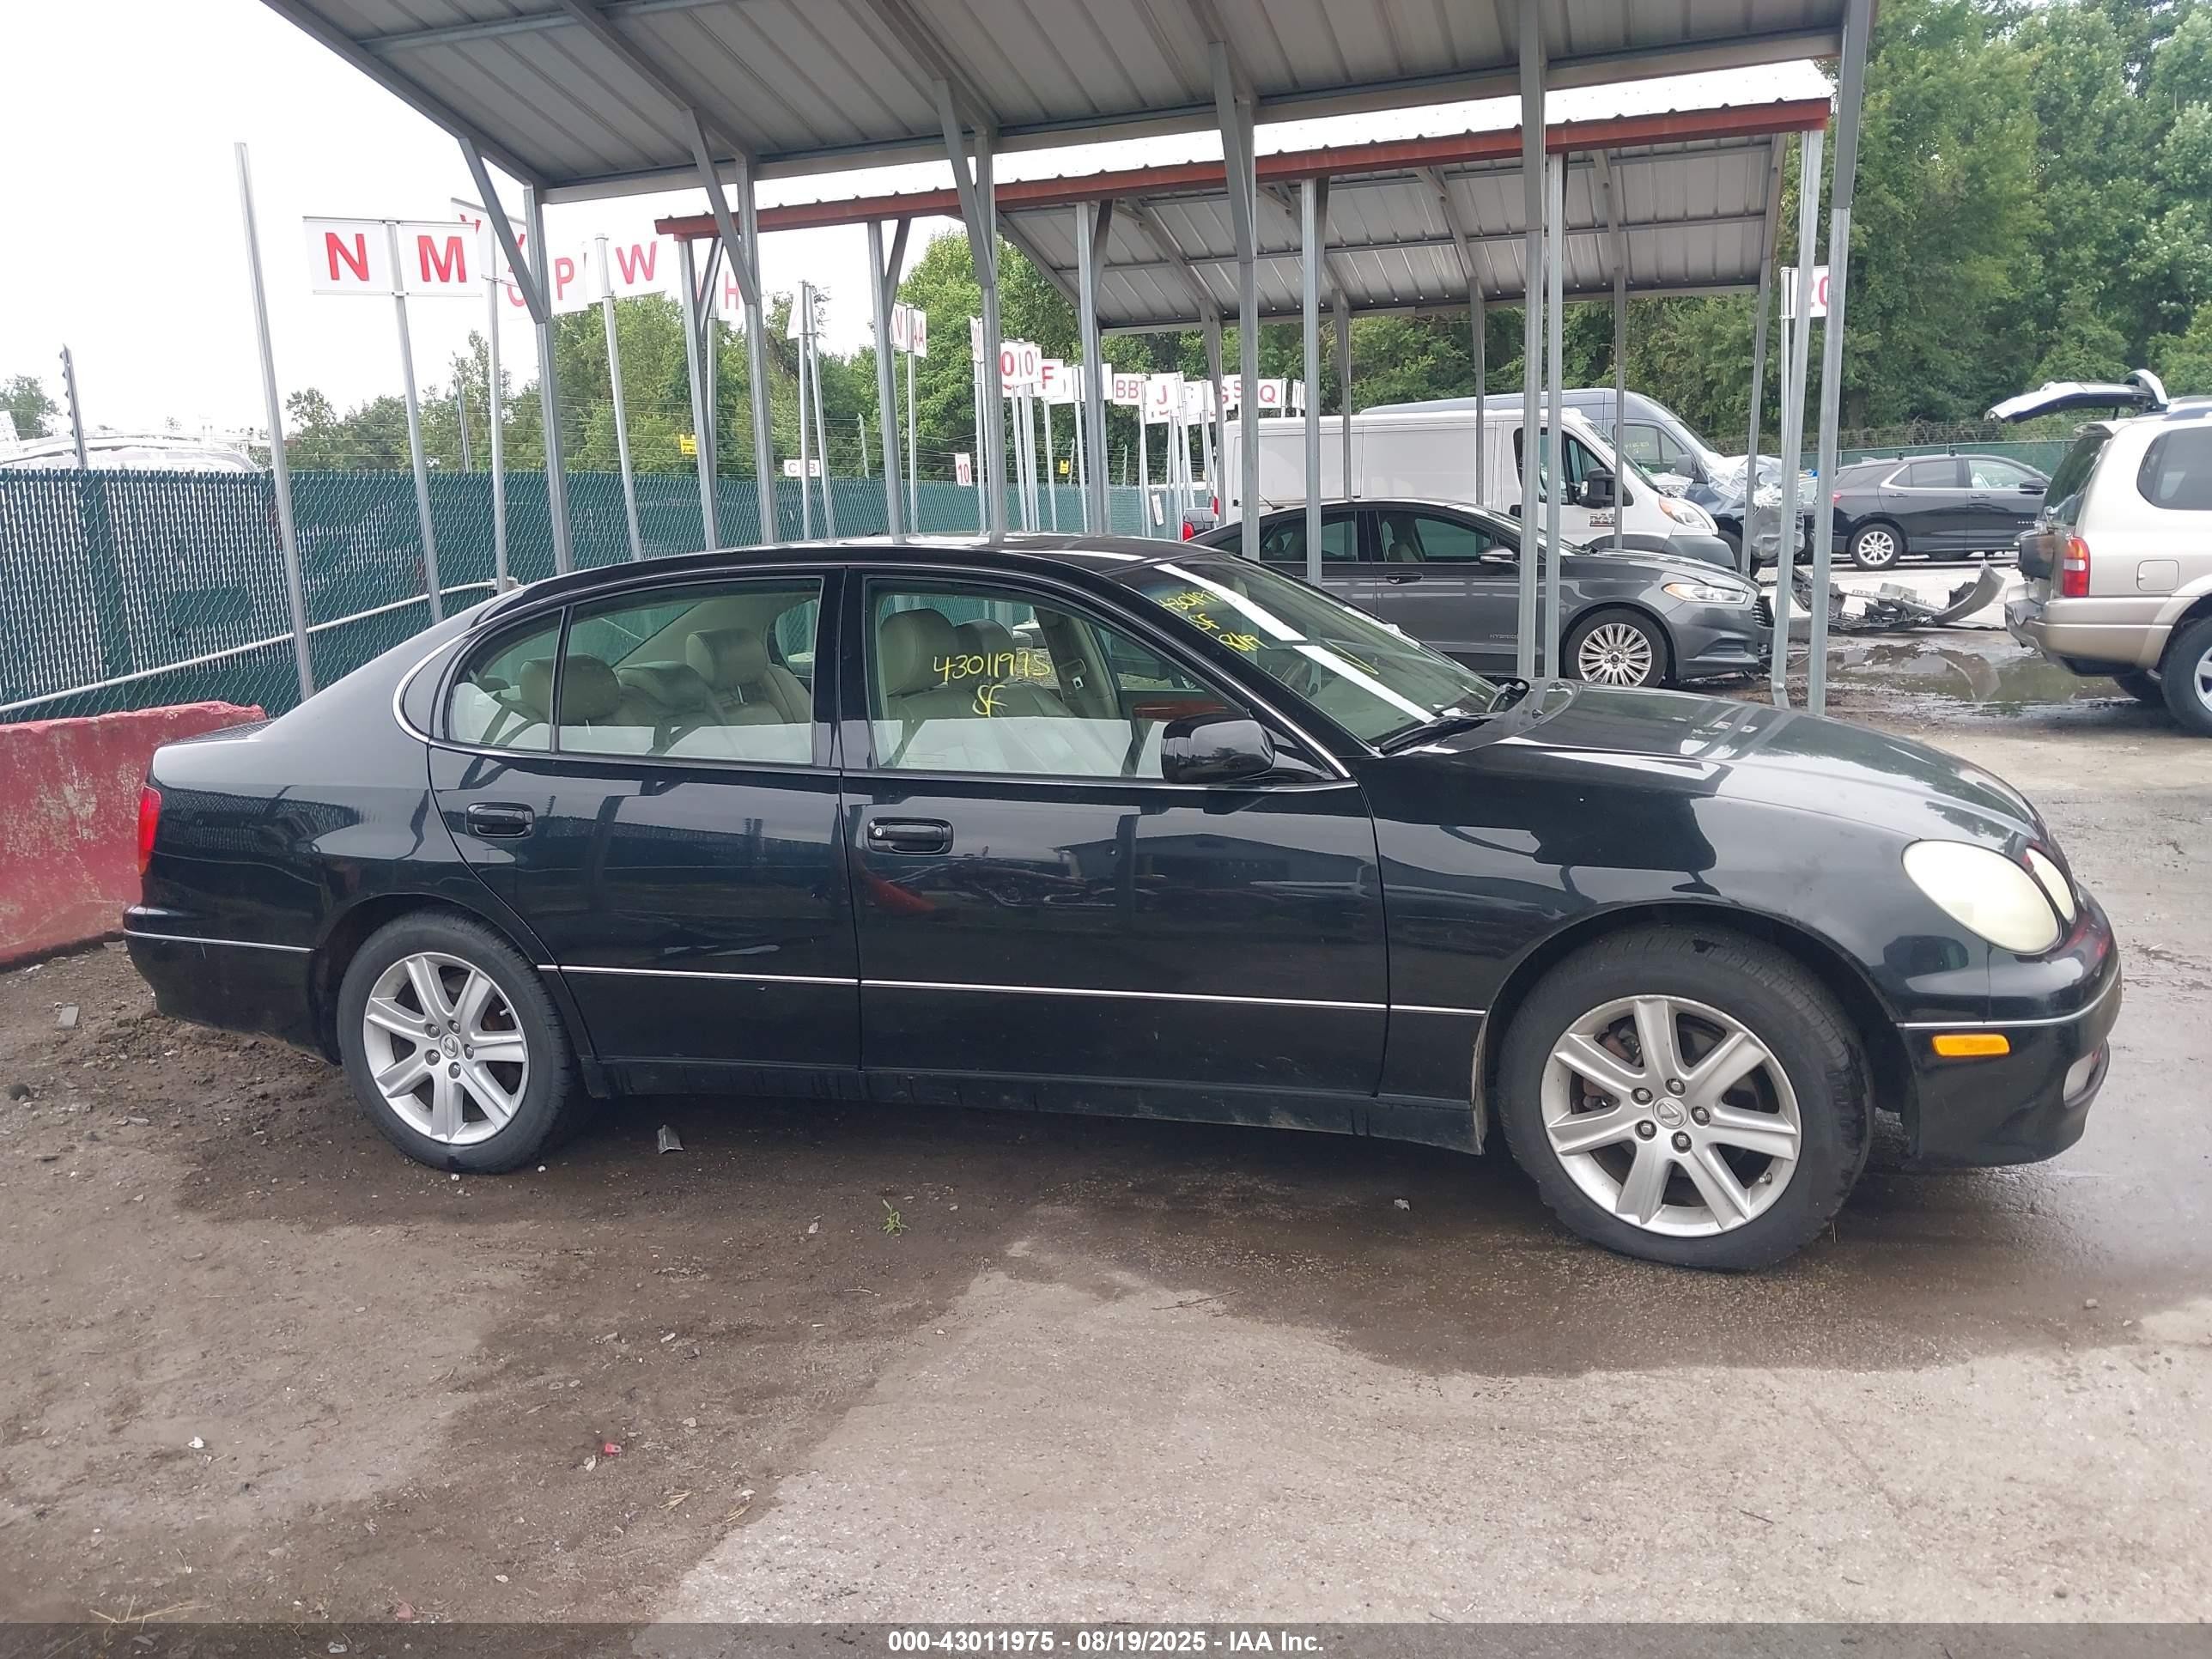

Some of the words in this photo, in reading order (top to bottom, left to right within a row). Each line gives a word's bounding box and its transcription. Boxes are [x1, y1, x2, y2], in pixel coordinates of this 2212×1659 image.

[325, 232, 369, 282] N
[417, 234, 467, 283] M
[615, 241, 657, 285] W
[555, 257, 574, 301] P
[1042, 366, 1054, 390] F
[1115, 380, 1139, 399] BB
[1156, 385, 1168, 405] J
[1259, 384, 1276, 404] Q
[933, 651, 1051, 682] 43011975
